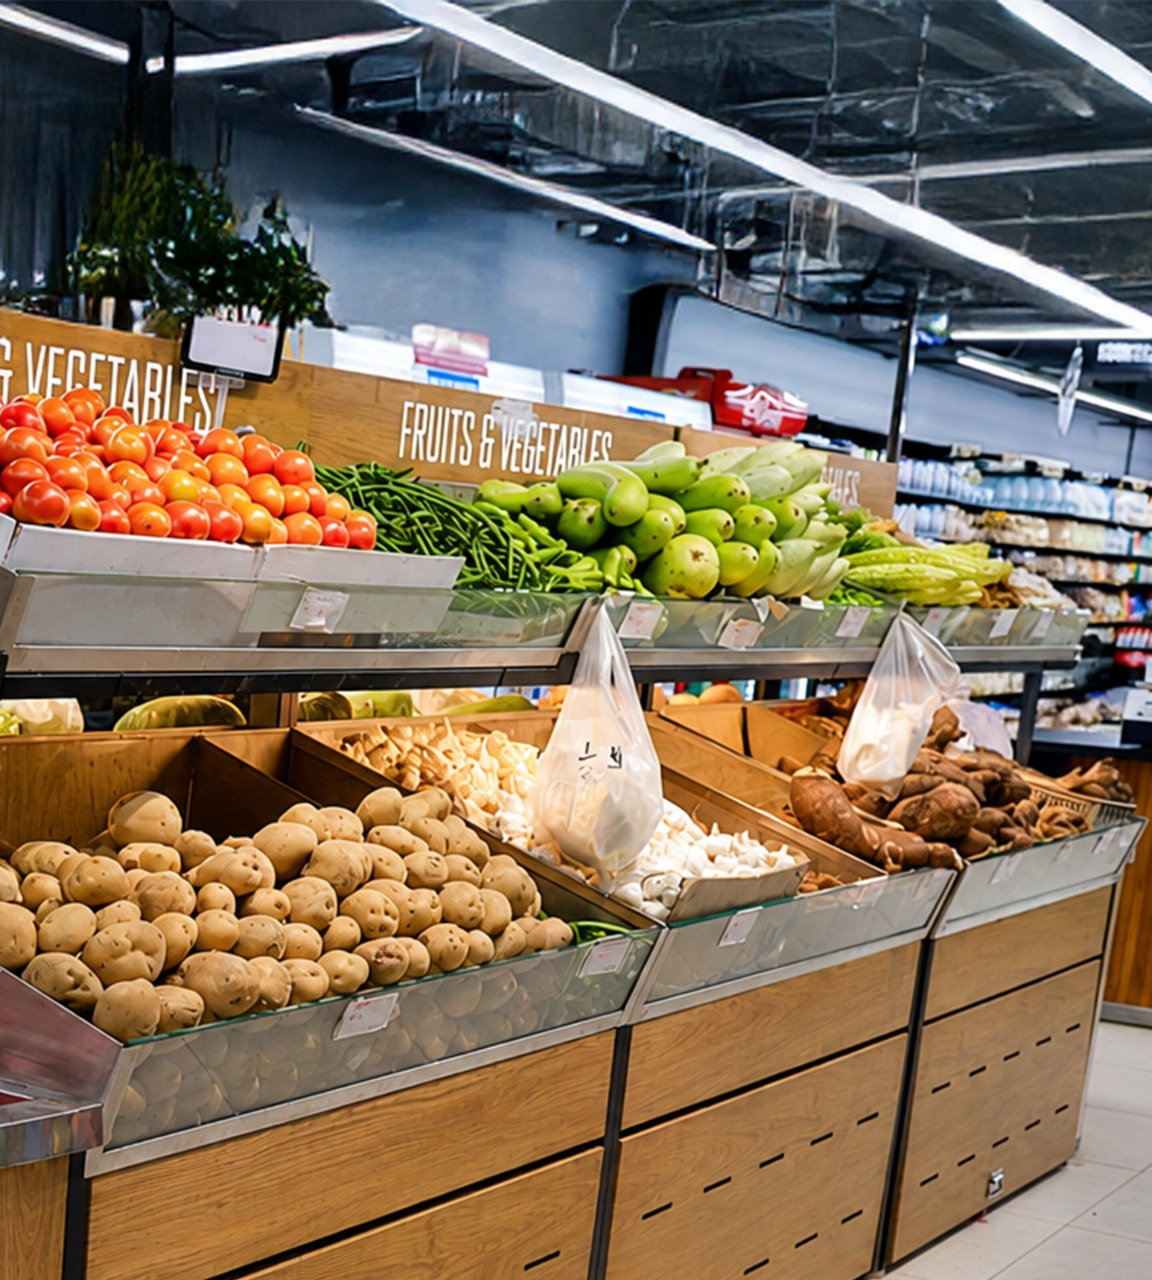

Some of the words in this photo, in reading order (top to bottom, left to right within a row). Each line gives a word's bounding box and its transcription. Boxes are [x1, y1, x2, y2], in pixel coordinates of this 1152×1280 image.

[399, 401, 475, 466] FRUITS
[479, 414, 495, 468] &
[501, 415, 612, 477] VEGETABLES
